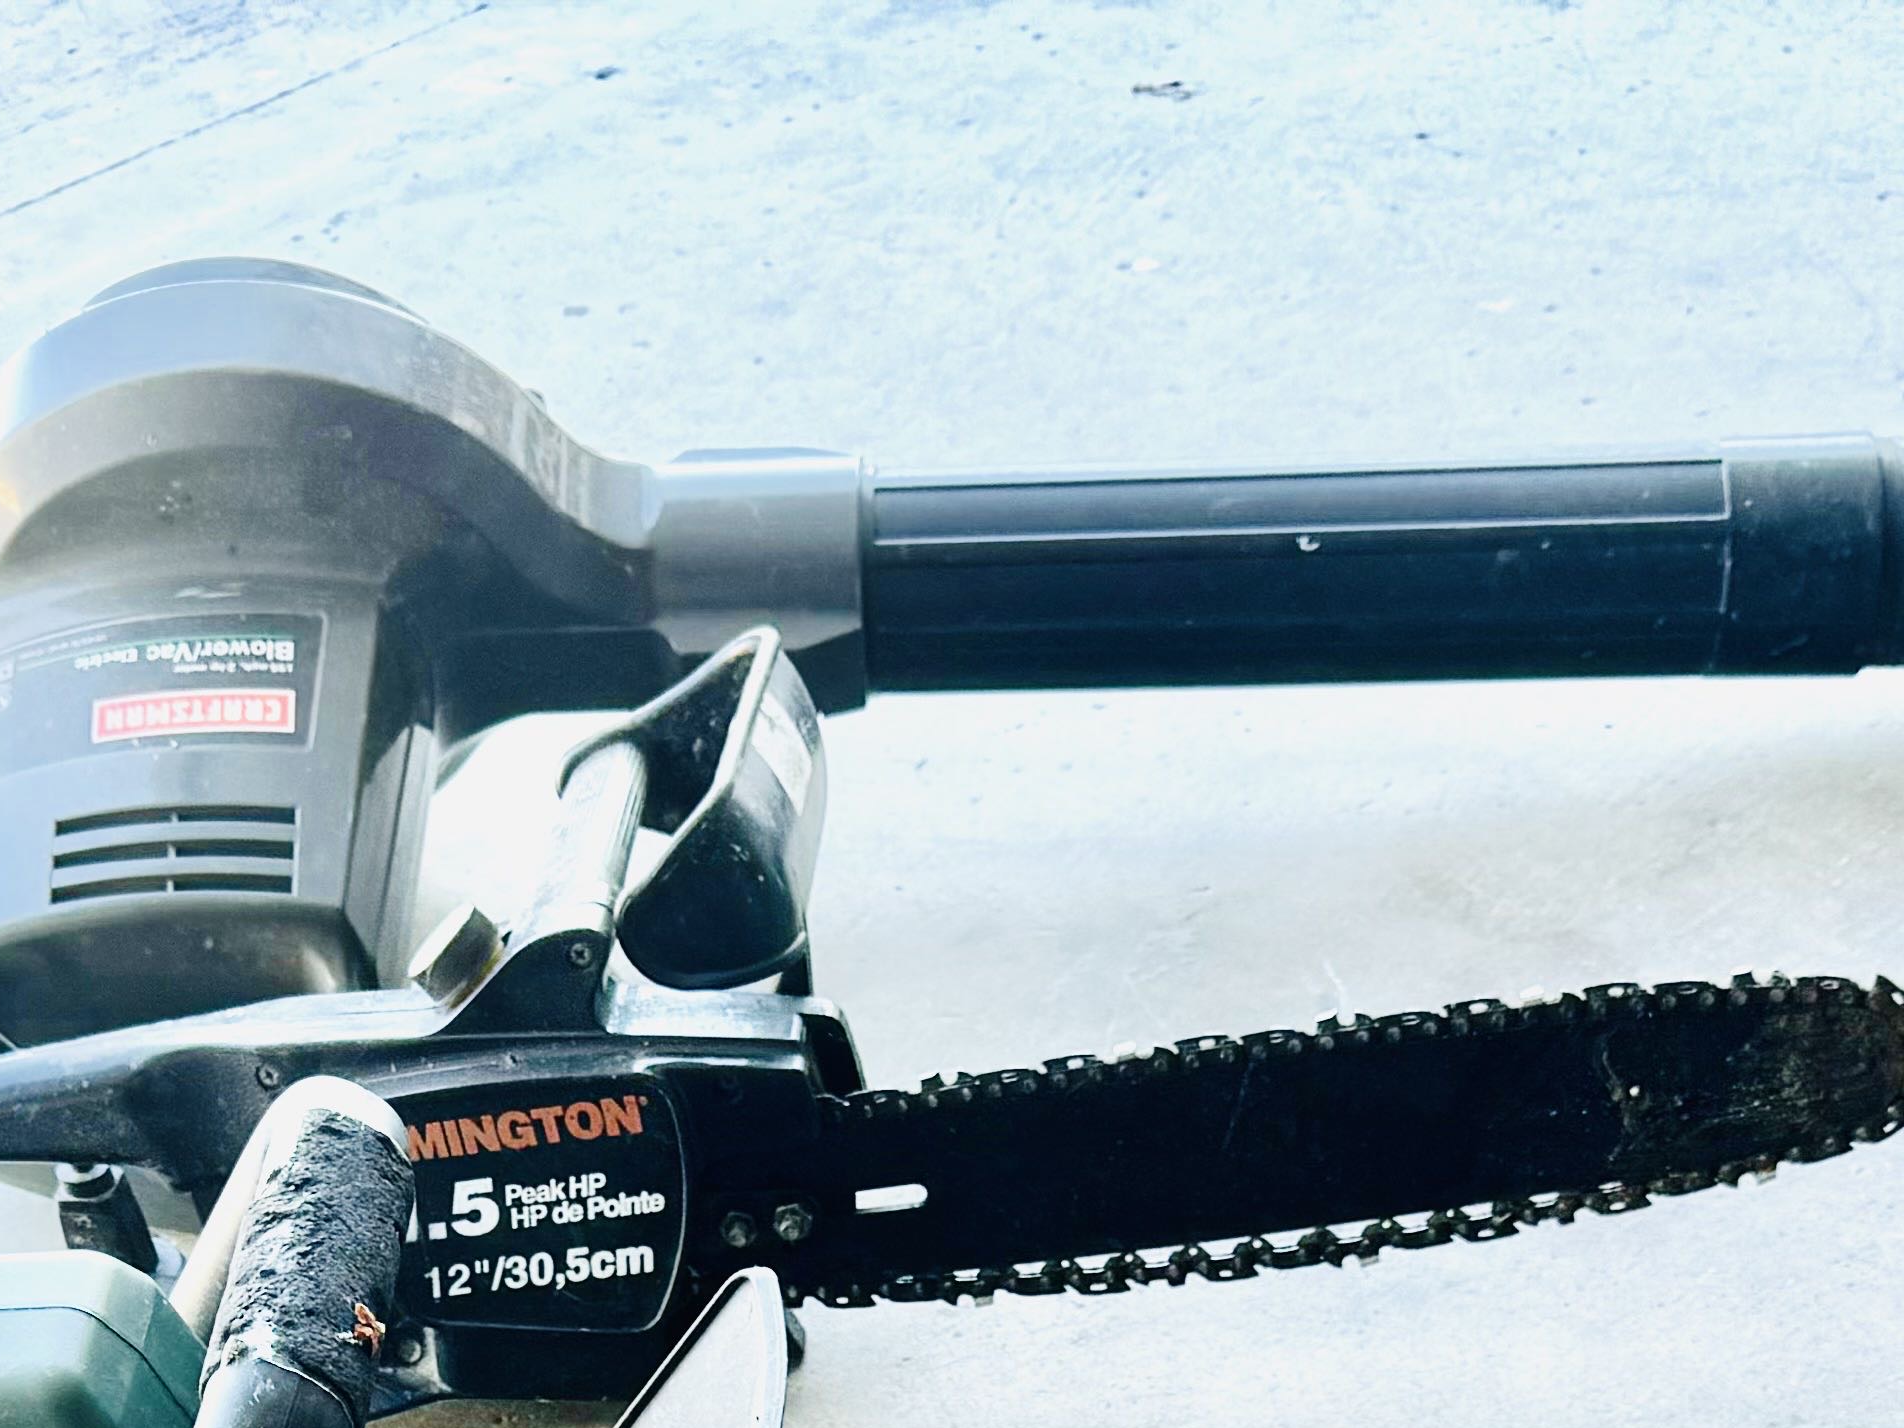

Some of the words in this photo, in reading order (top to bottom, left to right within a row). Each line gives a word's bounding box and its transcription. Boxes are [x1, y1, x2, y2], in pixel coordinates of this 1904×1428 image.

[74, 648, 139, 670] Electric
[146, 640, 295, 662] Blower/Vac
[104, 697, 283, 731] CRAFTSMAN
[408, 1095, 644, 1163] MINGTON
[505, 1178, 566, 1207] Peak
[569, 1172, 607, 1199] HP
[511, 1204, 547, 1229] HP
[552, 1202, 584, 1224] de
[587, 1191, 666, 1220] Pointe
[425, 1245, 655, 1299] 12"/30,5cm
